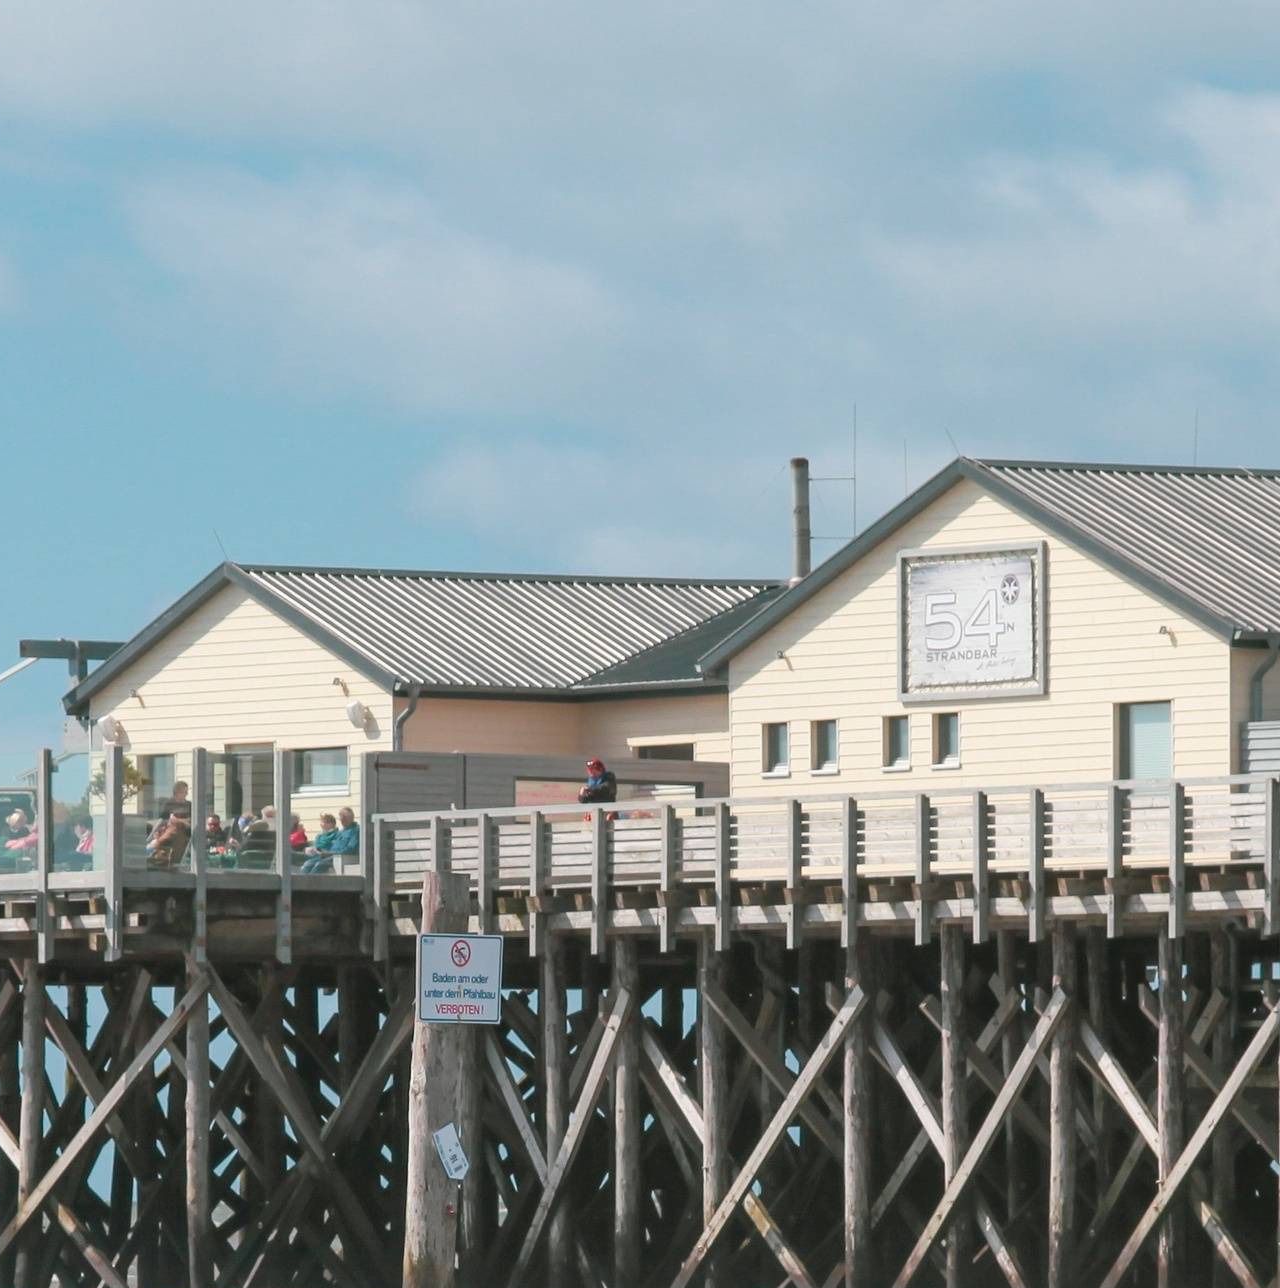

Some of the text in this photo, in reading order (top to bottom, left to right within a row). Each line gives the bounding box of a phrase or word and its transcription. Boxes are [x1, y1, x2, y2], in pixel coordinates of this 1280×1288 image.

[1006, 623, 1015, 632] N
[926, 649, 998, 663] STRANDBAR
[432, 973, 457, 983] Baden
[471, 974, 488, 984] oder
[424, 988, 496, 999] unter dem Pfahlbau
[435, 1004, 480, 1014] VERBOTEN
